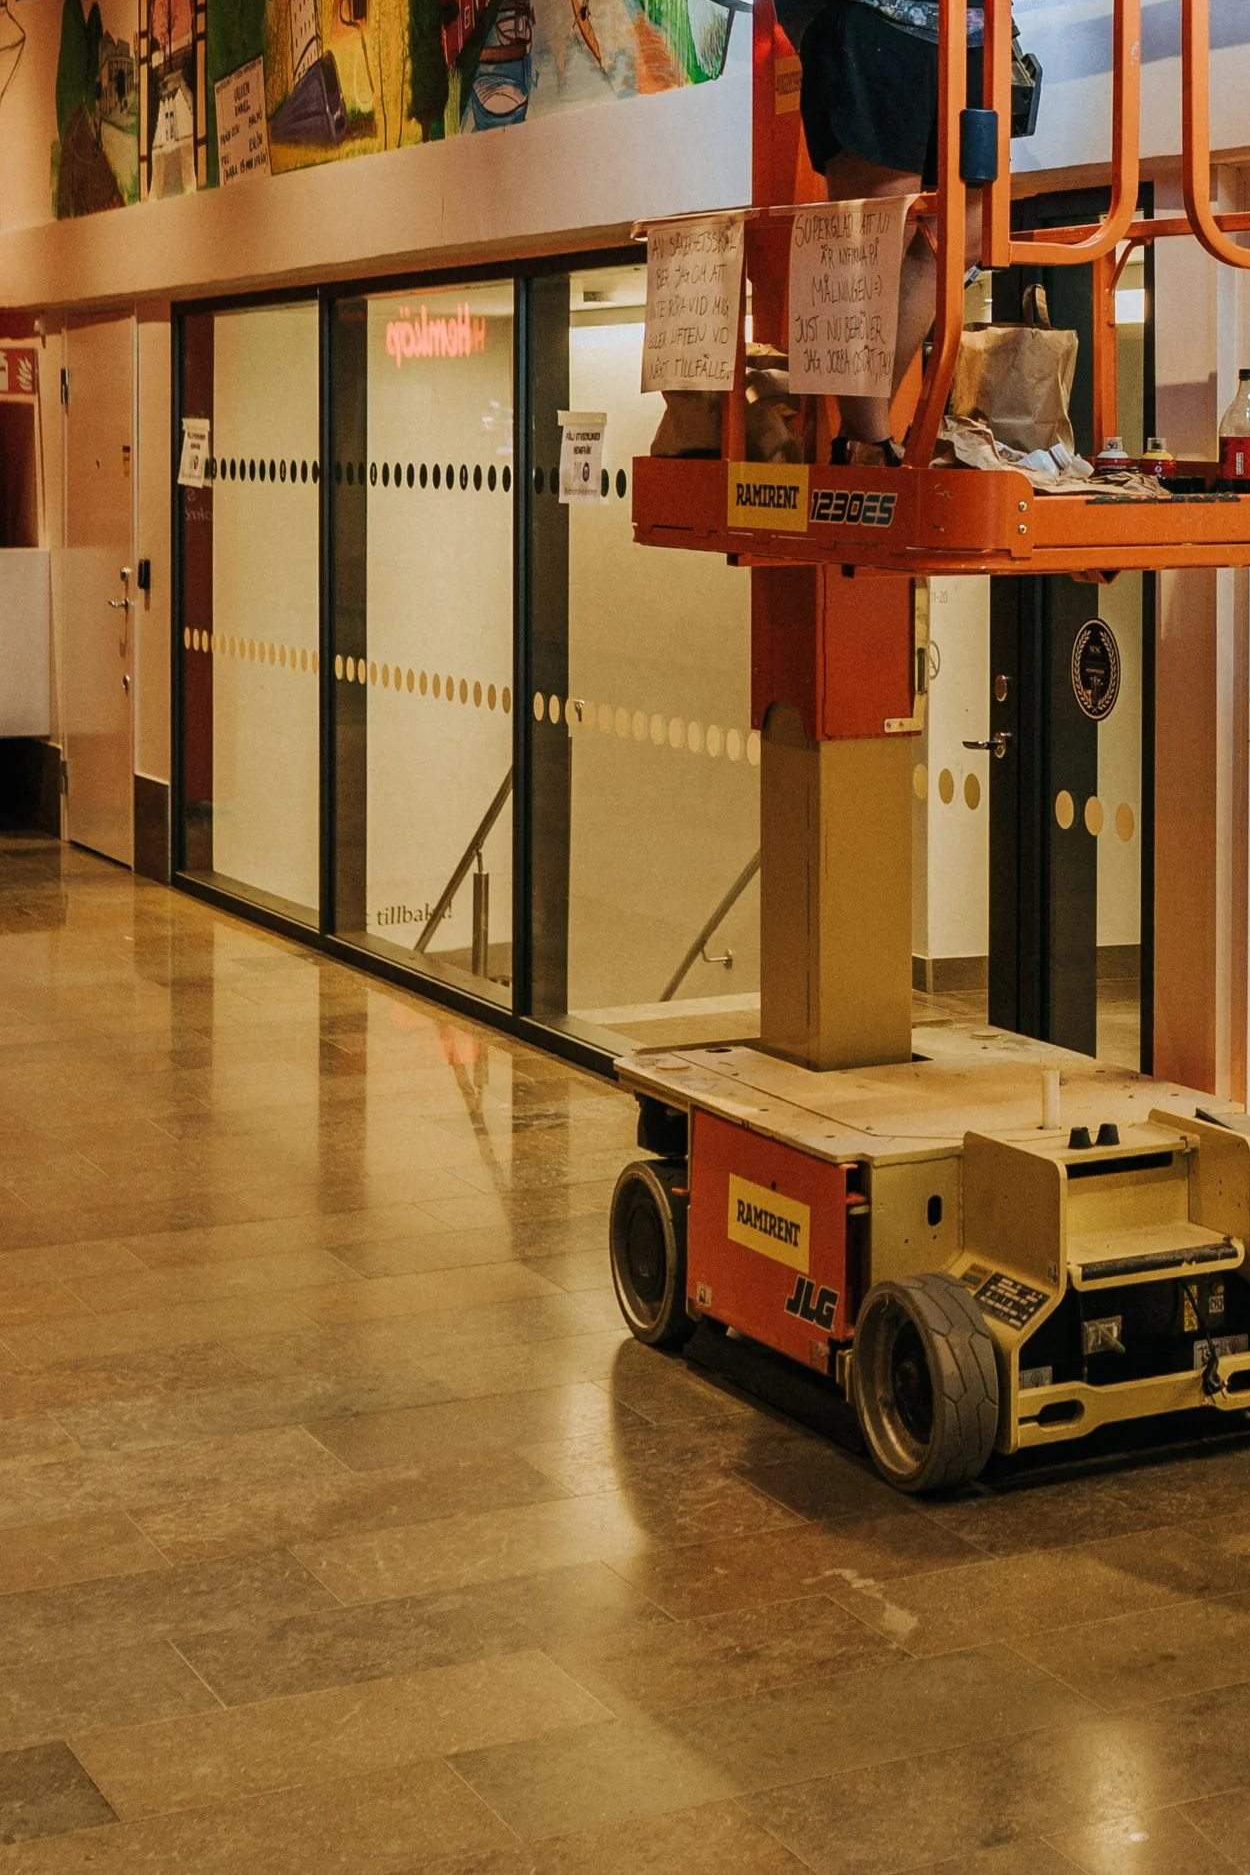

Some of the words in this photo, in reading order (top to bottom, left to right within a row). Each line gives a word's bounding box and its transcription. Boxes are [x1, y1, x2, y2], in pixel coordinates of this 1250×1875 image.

[688, 295, 708, 317] VID
[795, 314, 820, 344] JUST
[736, 482, 800, 510] RAMIRENT
[809, 489, 898, 528] 1230ES
[736, 1198, 801, 1247] RAMIRENT
[784, 1274, 840, 1333] JLG
